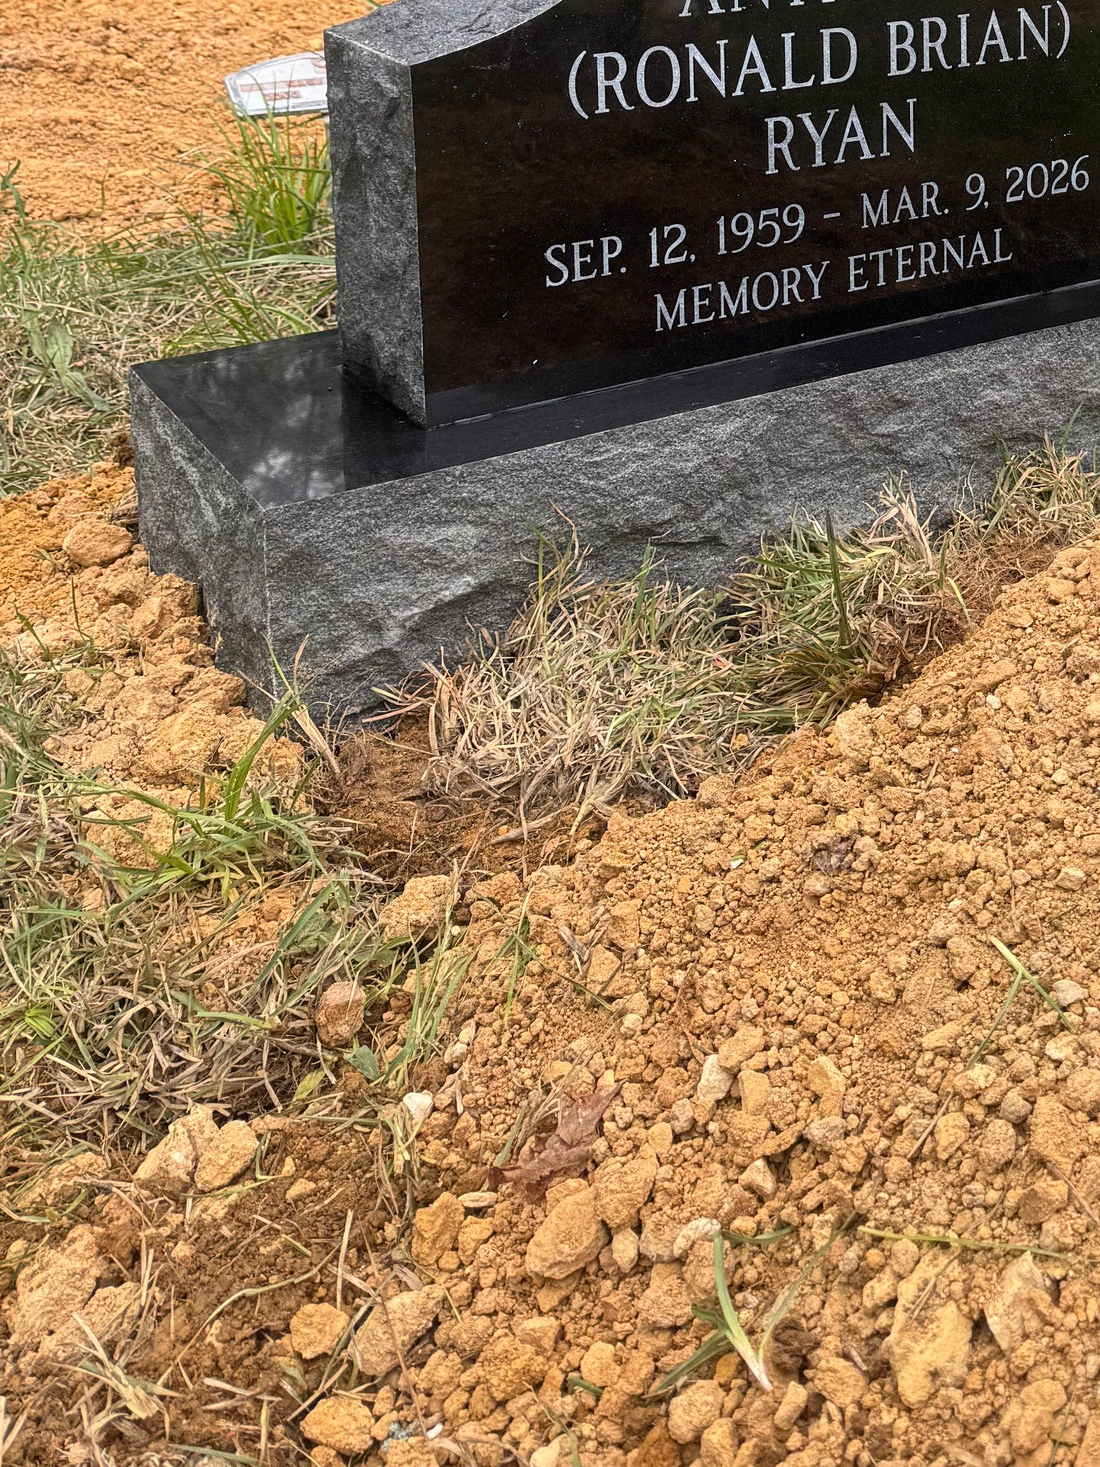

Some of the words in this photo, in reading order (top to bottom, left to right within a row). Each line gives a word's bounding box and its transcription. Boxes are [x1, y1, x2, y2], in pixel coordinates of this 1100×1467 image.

[568, 27, 858, 120] (RONALD
[886, 0, 1071, 77] BRIAN)
[764, 98, 917, 175] RYAN
[543, 235, 627, 288] SEP.
[648, 223, 696, 268] 12,
[716, 203, 806, 255] 1959
[860, 181, 950, 229] MAR.
[965, 173, 989, 211] 9,
[1006, 154, 1090, 203] 2026
[653, 261, 831, 332] MEMORY
[847, 228, 1013, 293] ETERNAL
